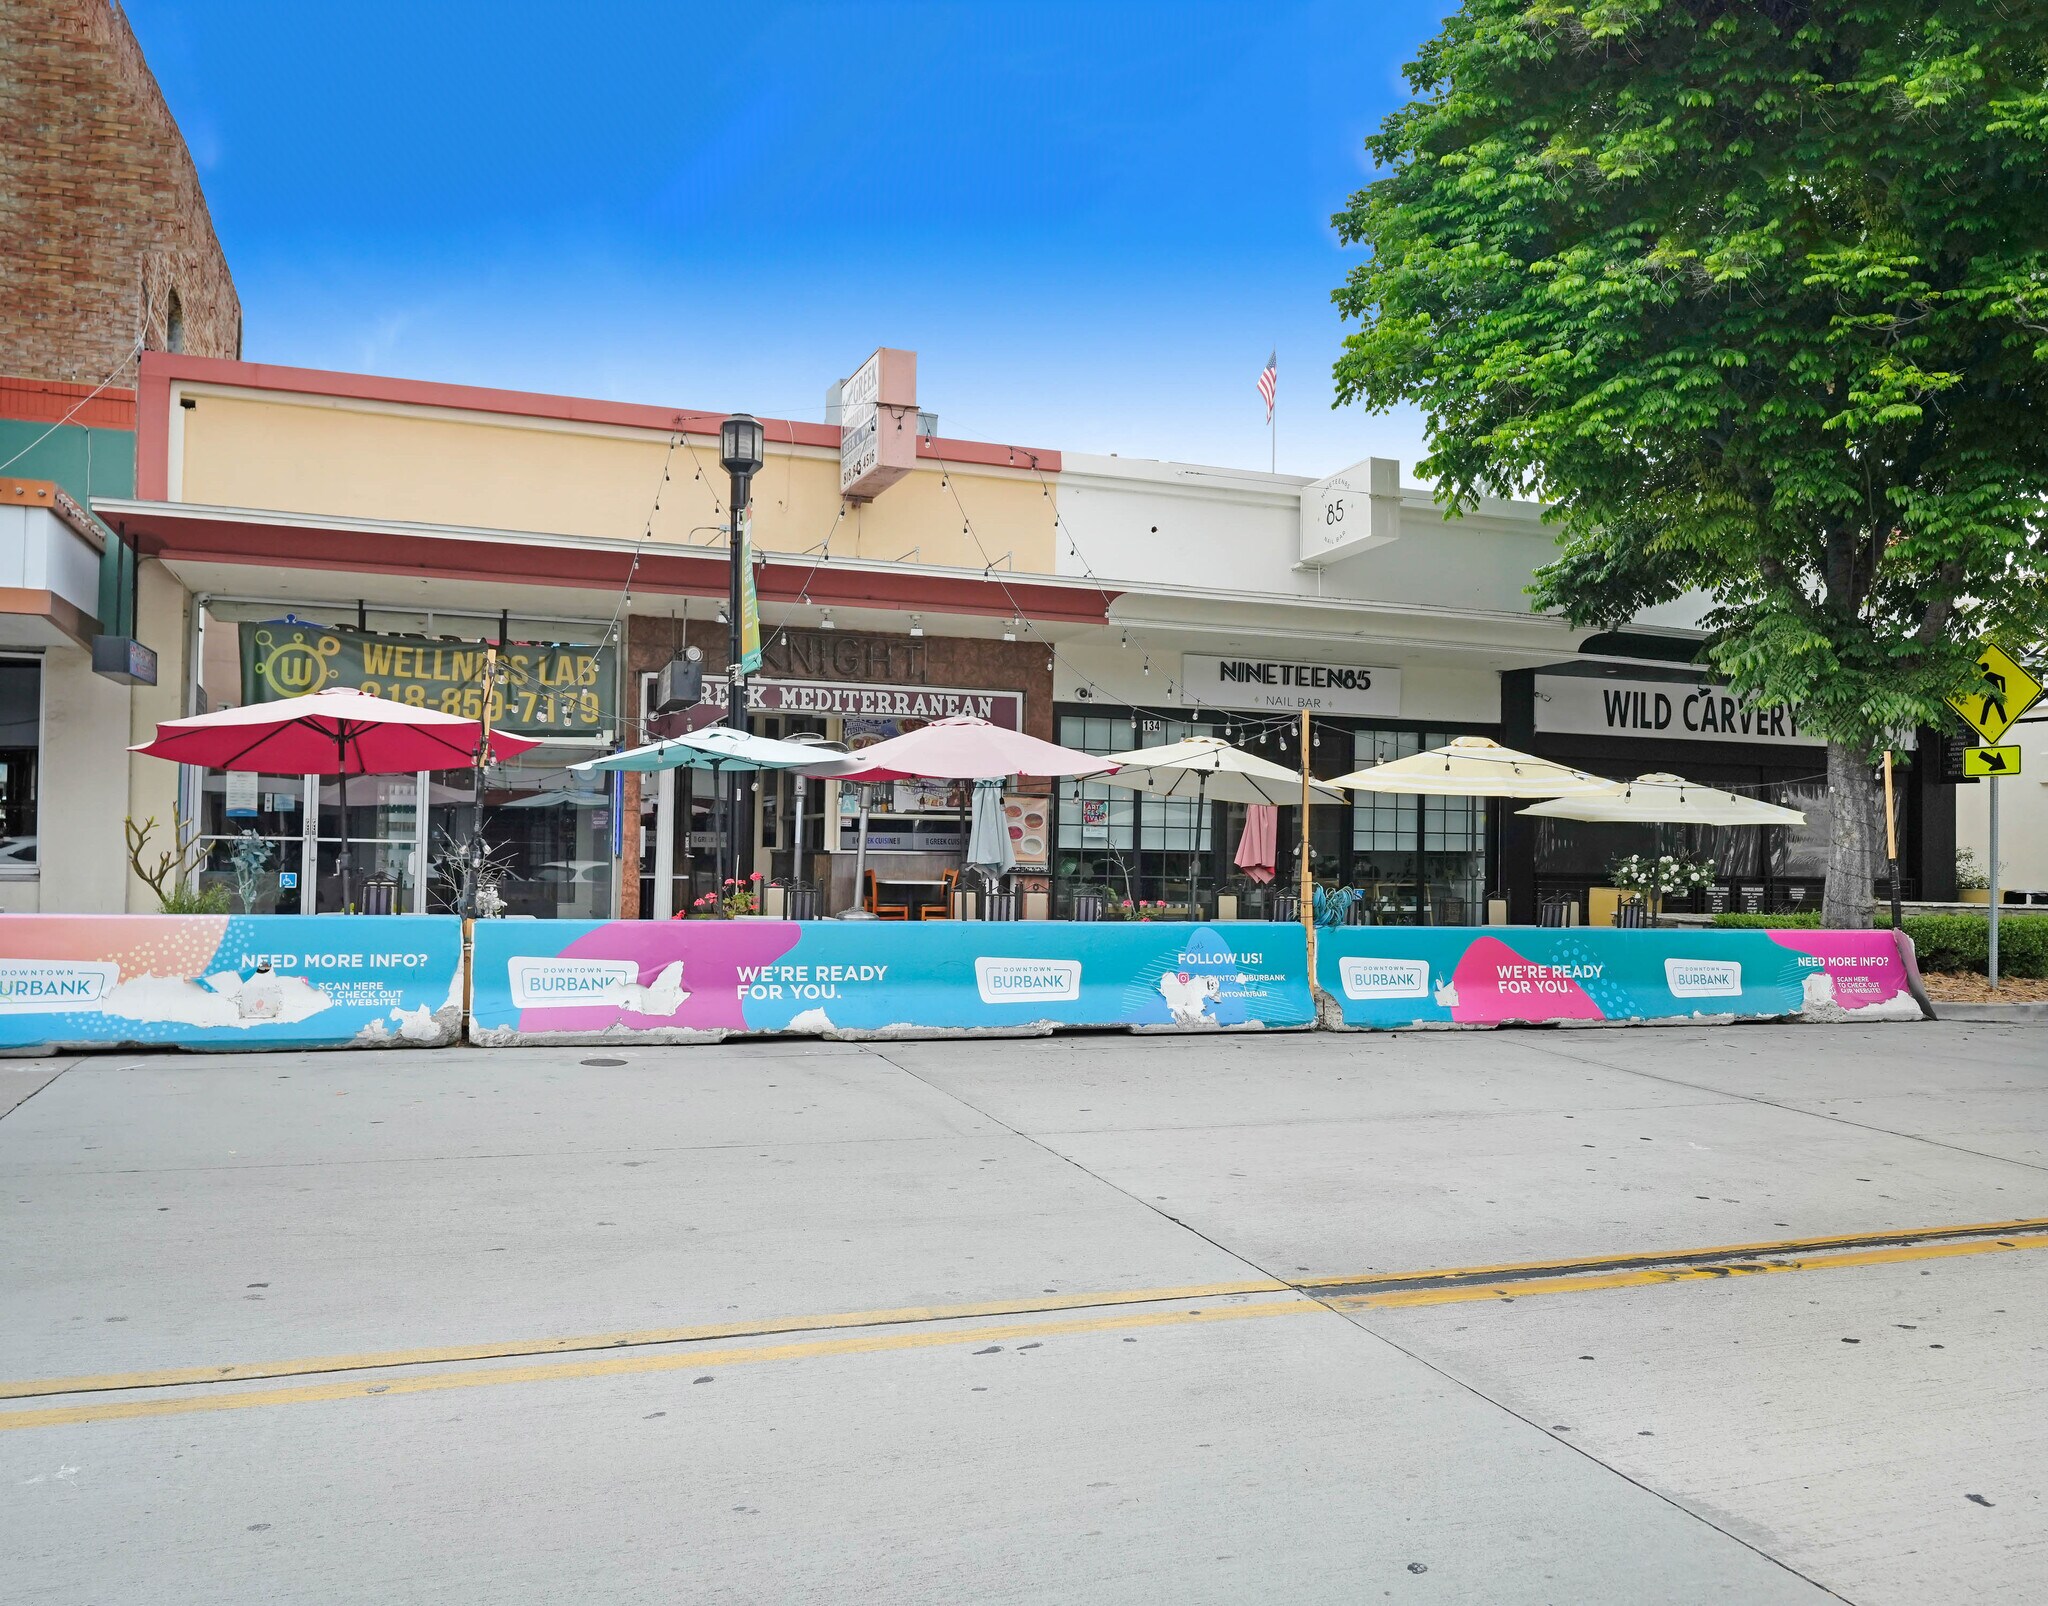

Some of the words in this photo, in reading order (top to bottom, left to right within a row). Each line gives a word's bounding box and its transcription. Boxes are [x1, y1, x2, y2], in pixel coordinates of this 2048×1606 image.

[854, 361, 877, 403] GREEK
[538, 655, 597, 686] LAB
[1220, 661, 1371, 691] NINETEEN85
[780, 687, 993, 719] MEDITERRANEAN
[1266, 696, 1294, 707] NAIL
[1298, 698, 1321, 709] BAR
[1603, 689, 1672, 730] WILD
[1683, 694, 1802, 737] CARVERY
[1143, 720, 1161, 732] 134
[875, 837, 897, 845] CUISINE
[241, 953, 299, 968] NEED
[304, 953, 364, 968] MORE
[370, 953, 428, 968] INFO?
[1178, 953, 1238, 965] FOLLOW
[1241, 953, 1263, 965] US!
[1798, 957, 1826, 967] NEED
[1828, 957, 1856, 967] MORE
[1860, 957, 1889, 967] INFO?
[736, 966, 808, 981] WE'RE
[816, 965, 888, 981] READY
[1497, 965, 1547, 979] WE'RE
[1552, 965, 1603, 979] READY
[318, 982, 350, 990] SCAN
[353, 982, 384, 990] HERE
[993, 975, 1064, 989] BURBANK
[1355, 973, 1415, 986] BURBANK
[1678, 973, 1729, 986] BURBANK
[0, 980, 90, 995] URBANK
[737, 984, 785, 1000] FOR
[790, 984, 842, 1000] YOU.
[1498, 980, 1532, 994] FOR
[1534, 980, 1573, 994] YOU.
[337, 990, 375, 999] CHECK
[379, 990, 403, 998] OUT
[346, 998, 401, 1006] WEBSITE!
